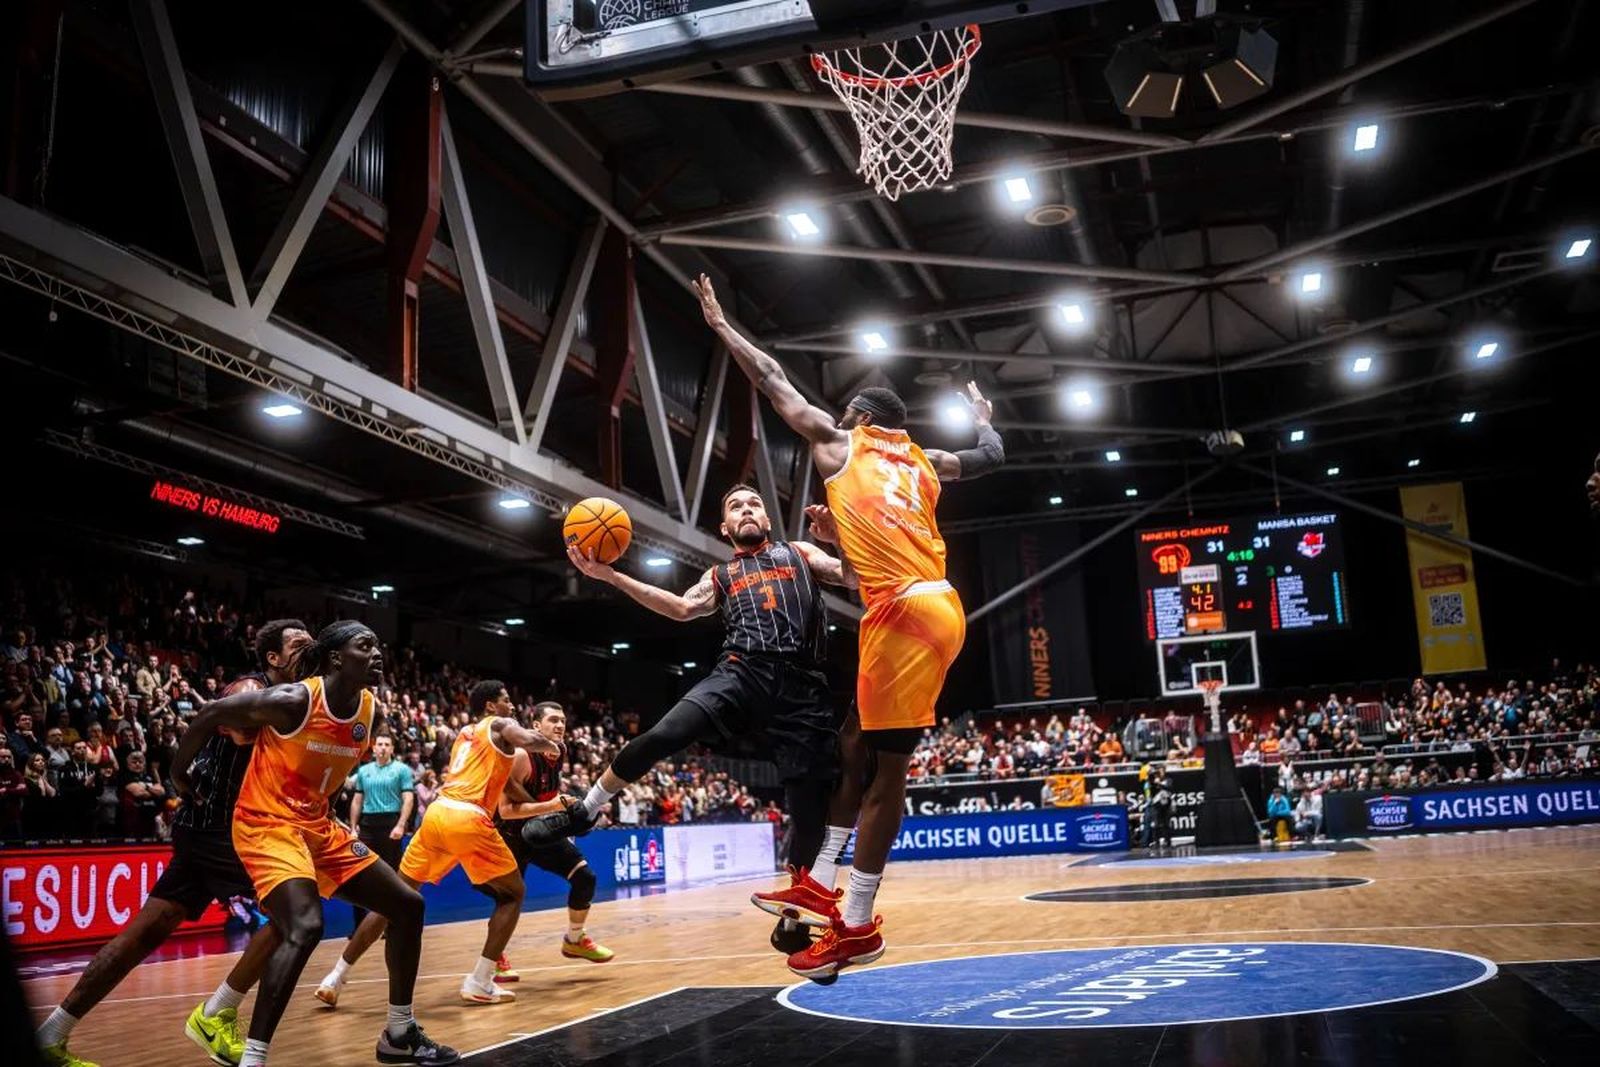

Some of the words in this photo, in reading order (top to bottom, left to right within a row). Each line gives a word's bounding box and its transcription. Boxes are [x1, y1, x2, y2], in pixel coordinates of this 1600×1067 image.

[643, 4, 689, 21] LEAGUE
[151, 480, 201, 511] NINERS
[202, 496, 220, 516] VS
[219, 502, 280, 533] HAMBURG
[1257, 518, 1297, 531] MANISA
[1297, 514, 1337, 527] BASKET
[1141, 530, 1178, 542] NINERS
[1179, 525, 1230, 538] CHEMNITZ
[1207, 540, 1224, 553] 31
[1253, 536, 1271, 549] 31
[1237, 573, 1248, 586] 2
[759, 585, 777, 611] 3
[1029, 626, 1051, 697] NINERS
[319, 767, 333, 794] 1
[1370, 806, 1408, 817] SACHSEN
[1424, 794, 1528, 821] SACHSEN
[1537, 789, 1600, 816] QUEL
[1081, 823, 1117, 833] SACHSEN
[1374, 814, 1406, 825] QUELLE
[988, 822, 1067, 845] QUELLE
[1084, 832, 1114, 842] QUELLE
